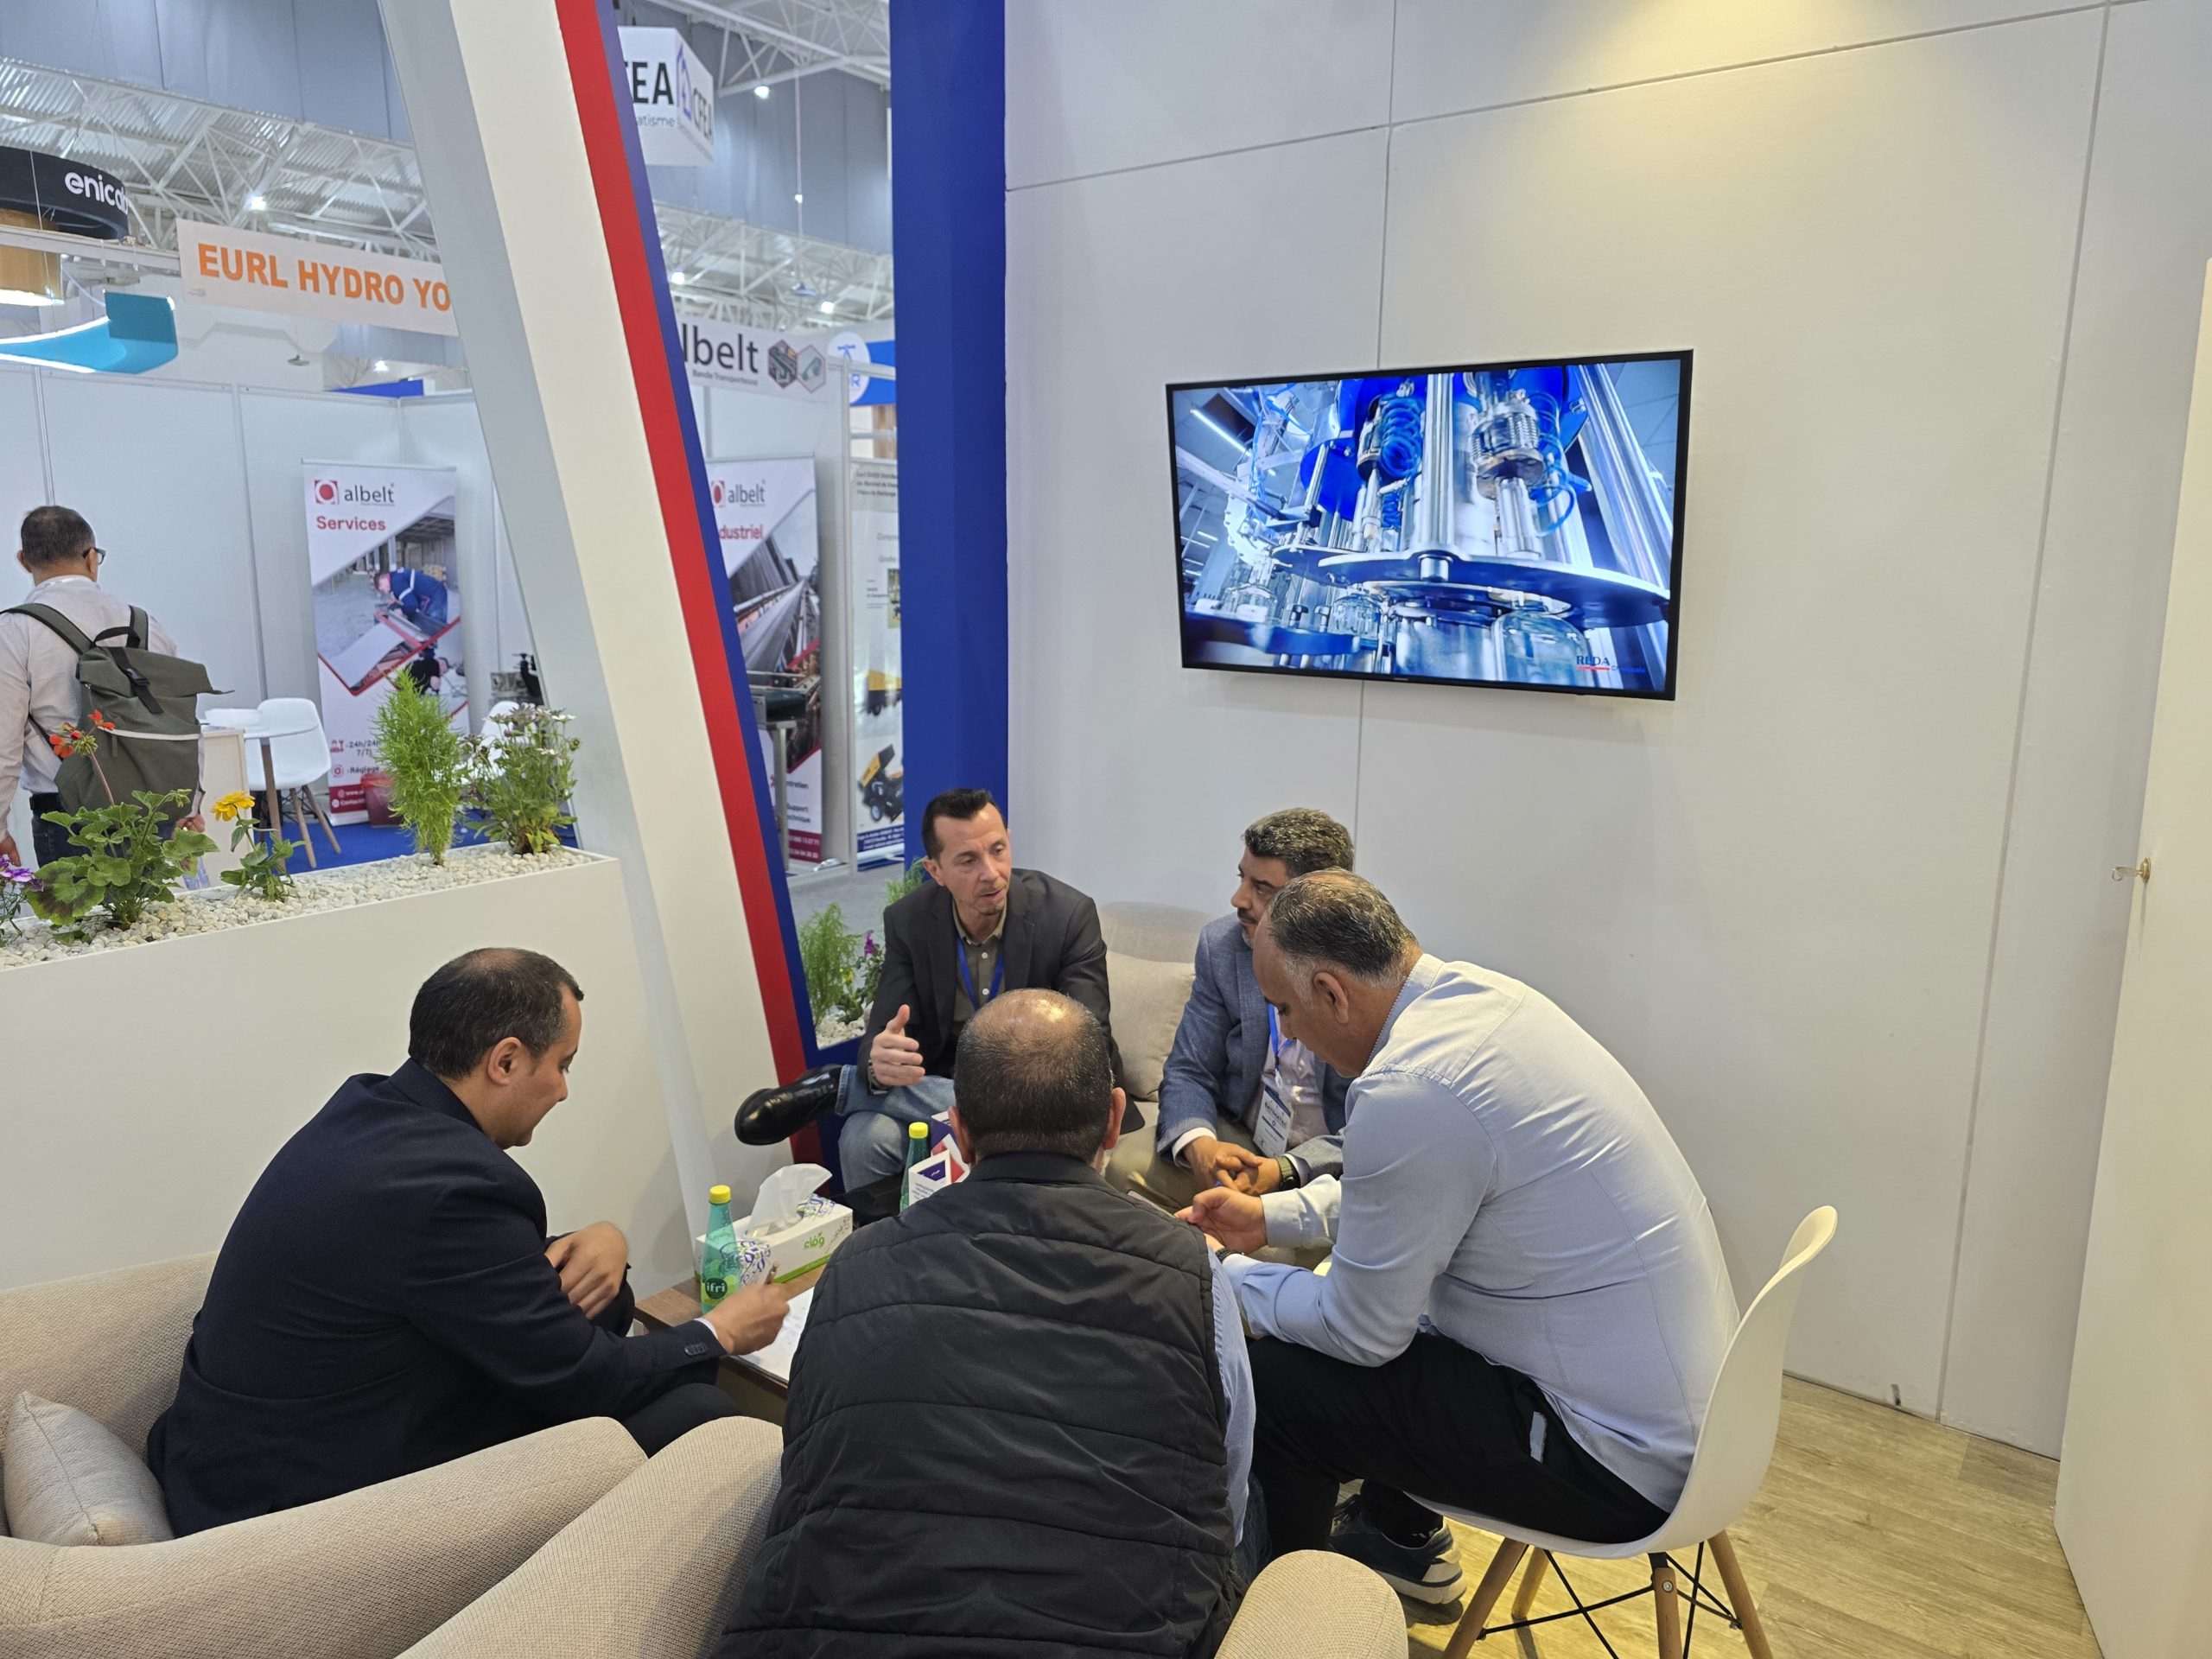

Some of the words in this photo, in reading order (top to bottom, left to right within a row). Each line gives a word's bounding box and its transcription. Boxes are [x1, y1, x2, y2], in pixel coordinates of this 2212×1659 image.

[198, 243, 288, 289] EURL
[297, 259, 404, 305] HYDRO
[412, 277, 451, 312] YO
[344, 484, 395, 503] albelt
[728, 483, 766, 503] albelt
[316, 516, 386, 531] Services
[706, 1281, 726, 1293] ifri
